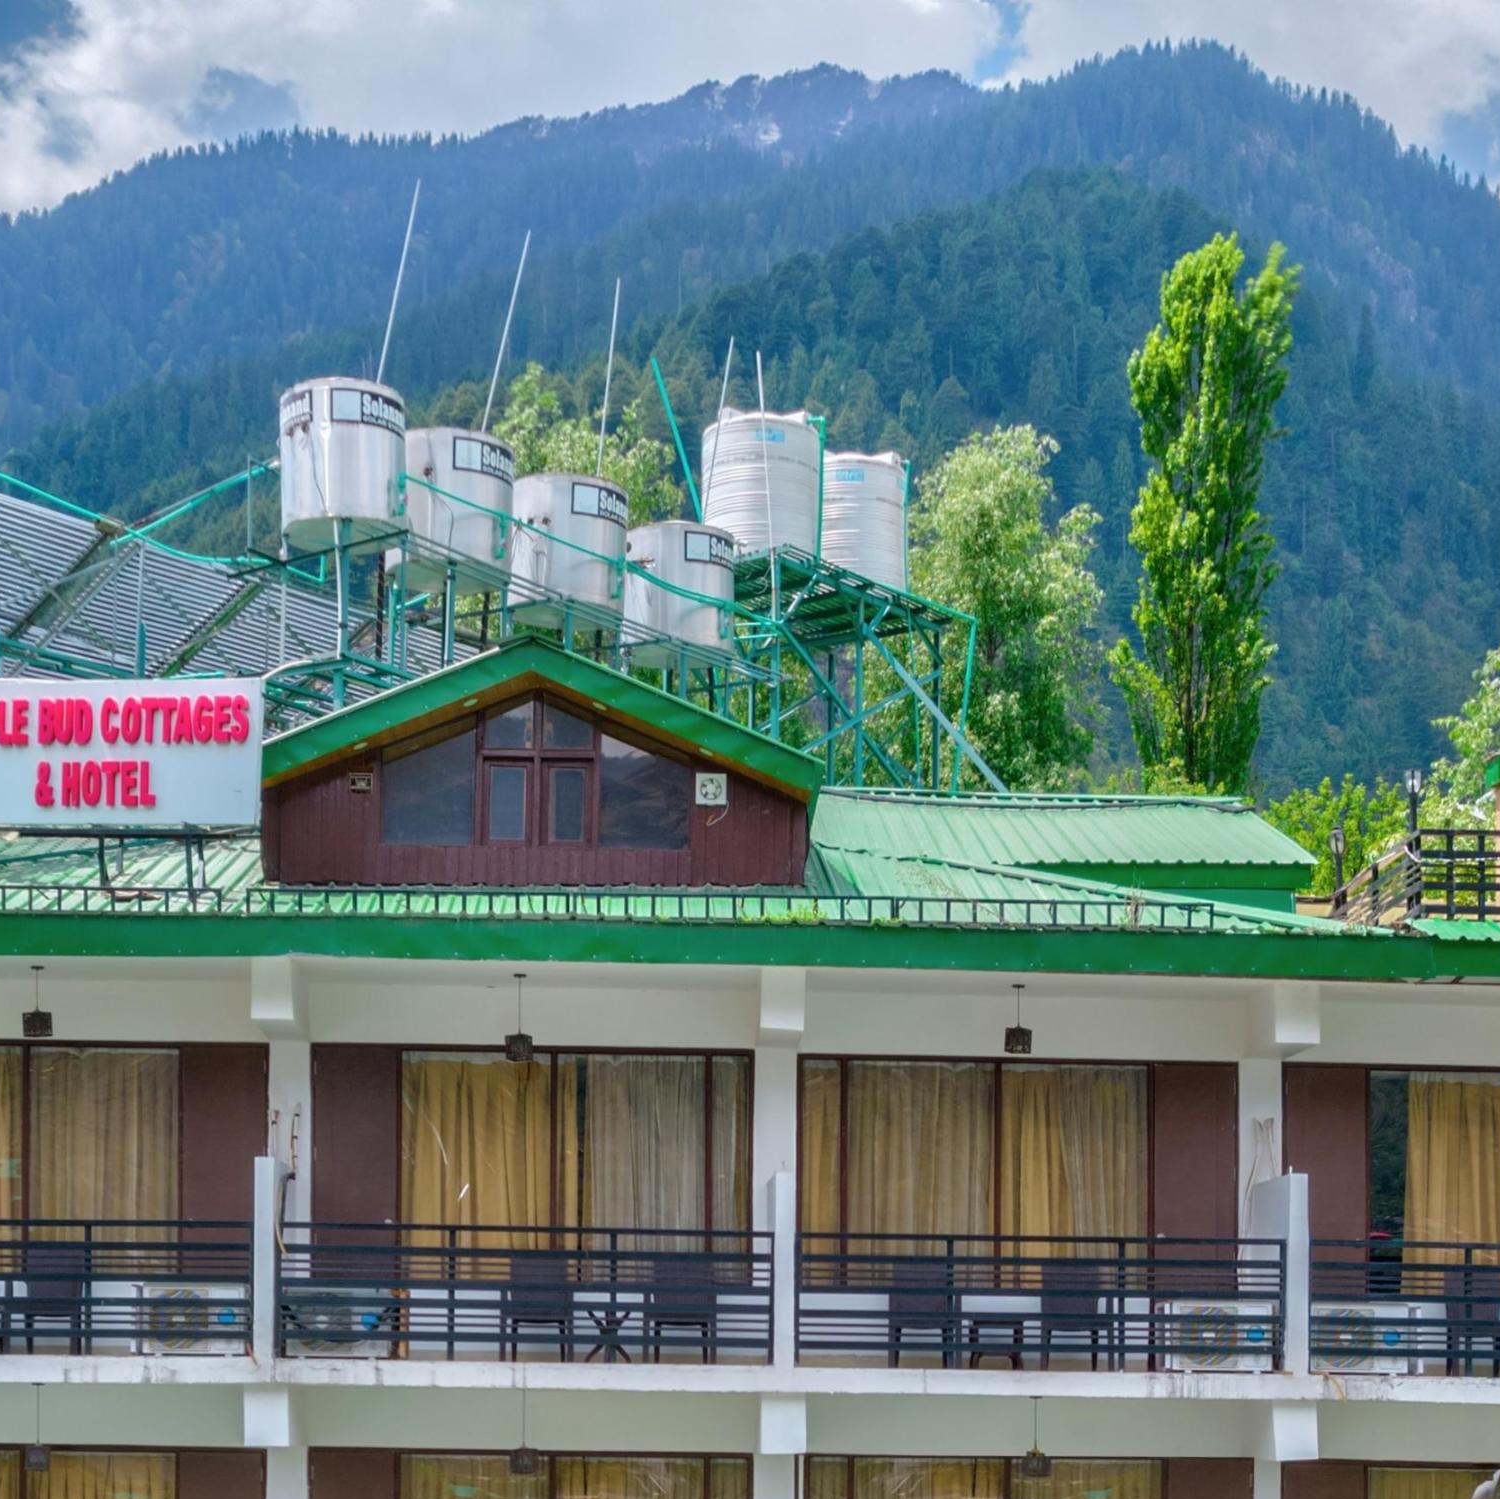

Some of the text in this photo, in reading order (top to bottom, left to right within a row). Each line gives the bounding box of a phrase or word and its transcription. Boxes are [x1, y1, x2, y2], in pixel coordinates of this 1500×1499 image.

[37, 698, 93, 746] BUD
[100, 694, 250, 745] COTTAGES
[34, 760, 156, 808] & HOTEL
